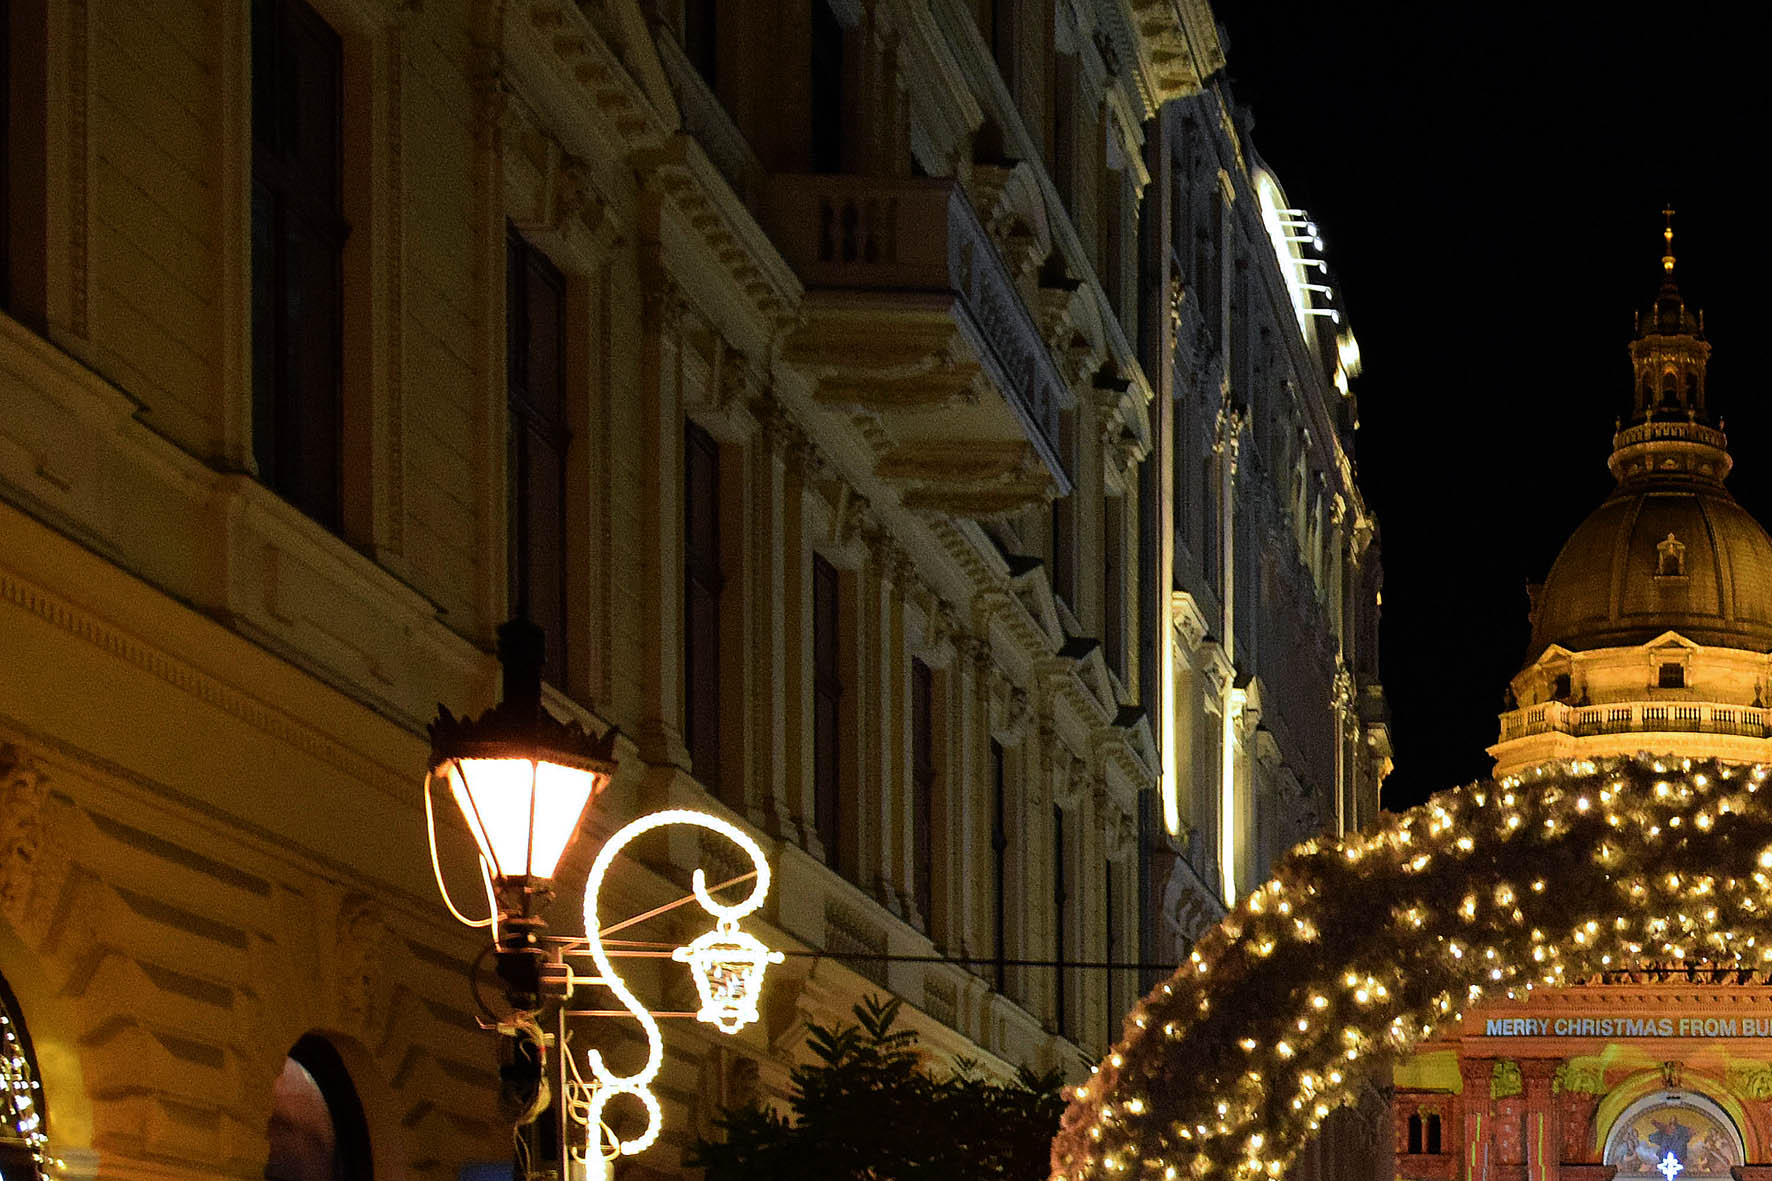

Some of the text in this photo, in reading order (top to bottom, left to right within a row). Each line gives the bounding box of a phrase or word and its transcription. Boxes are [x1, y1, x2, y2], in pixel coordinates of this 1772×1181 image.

[1486, 1018, 1550, 1036] MERRY
[1553, 1018, 1674, 1037] CHRISTMAS
[1679, 1018, 1737, 1037] FROM
